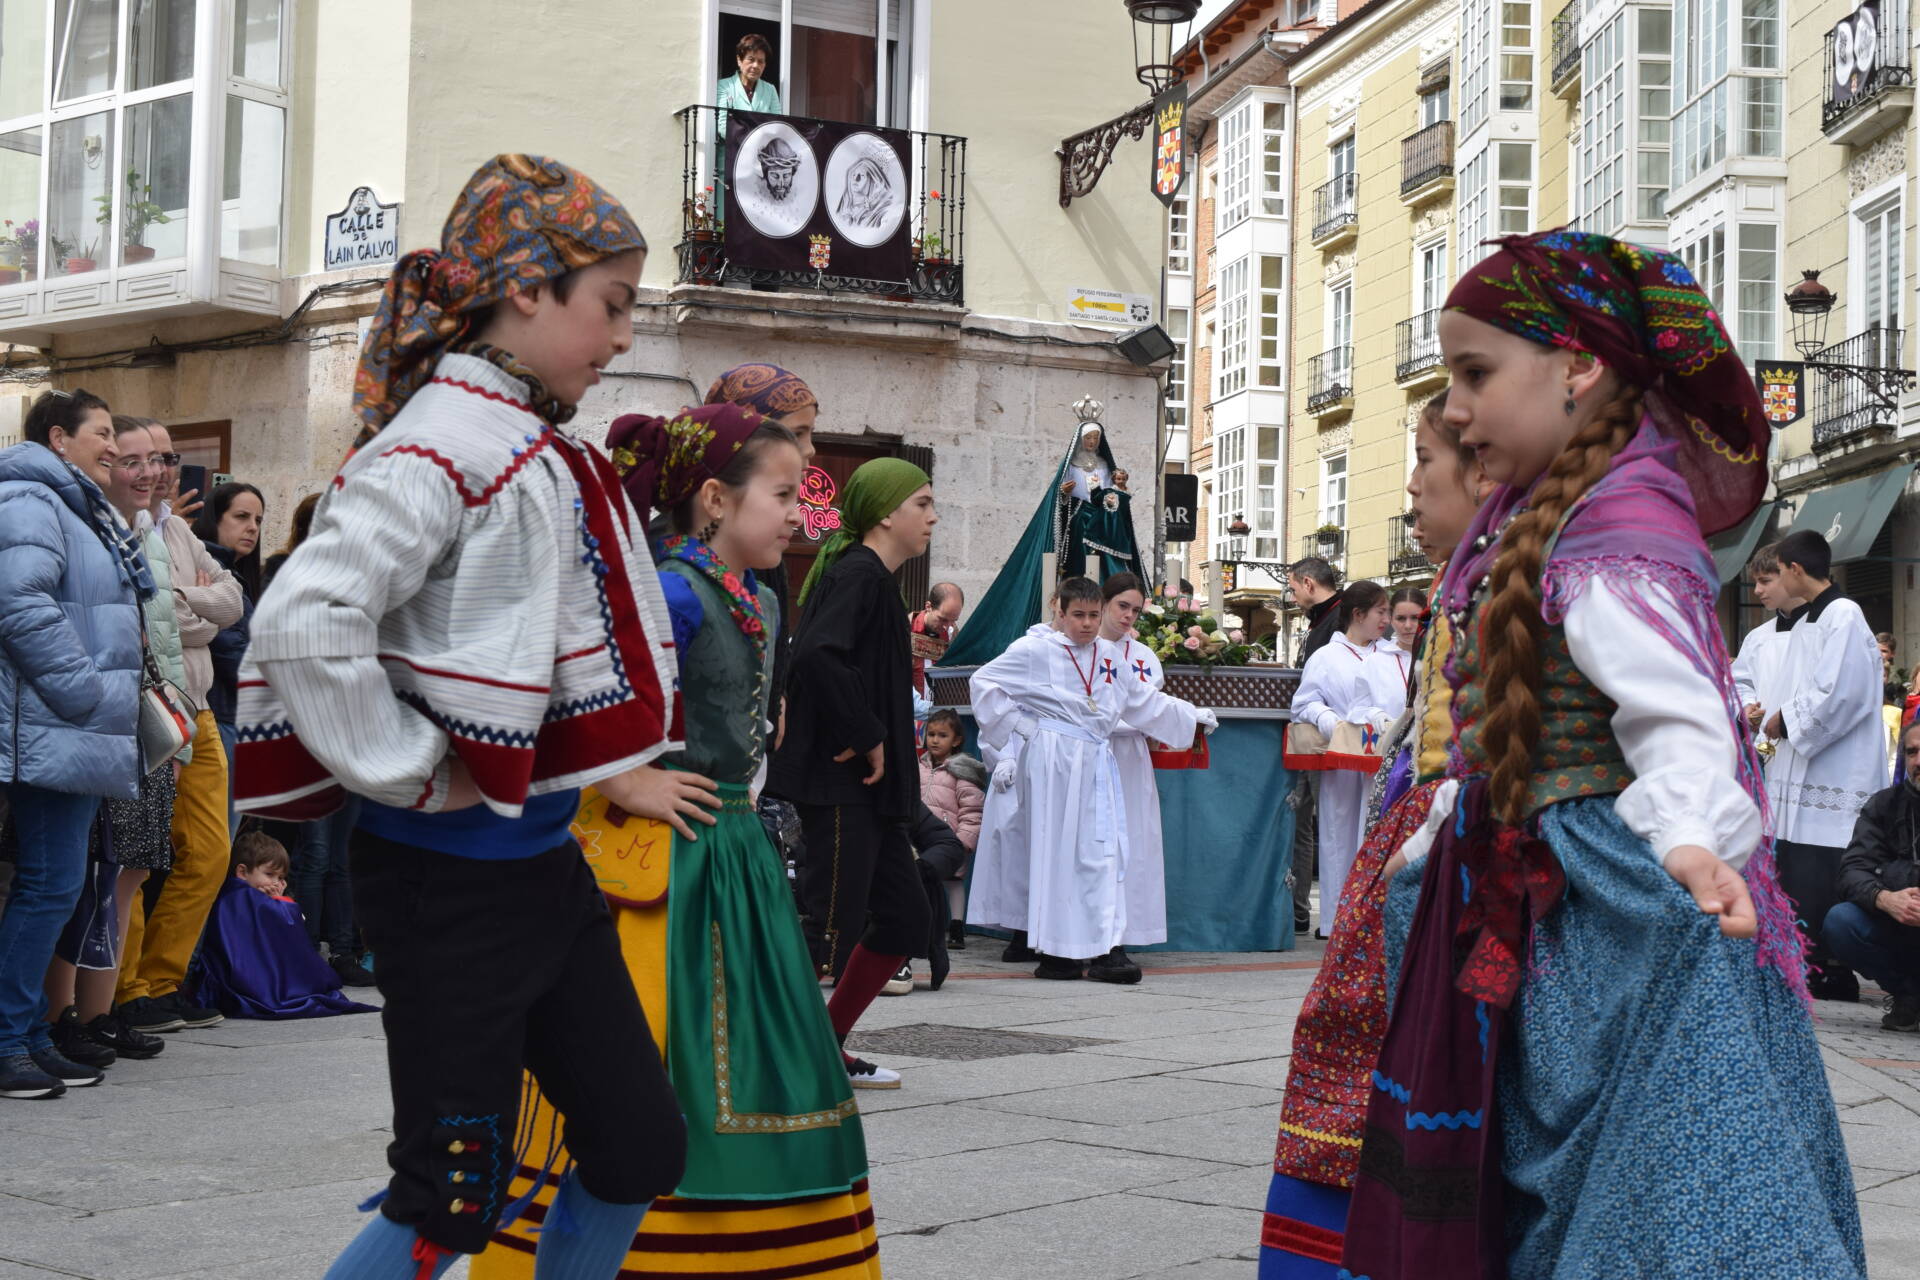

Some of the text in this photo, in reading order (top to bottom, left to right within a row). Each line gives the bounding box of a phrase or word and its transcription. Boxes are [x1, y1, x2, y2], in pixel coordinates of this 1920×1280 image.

[339, 211, 385, 234] CALLE
[329, 240, 394, 265] LAIN CALVO
[1076, 288, 1096, 296] REFUGIO
[1069, 312, 1091, 320] SANTIAGO
[1164, 506, 1190, 523] AR
